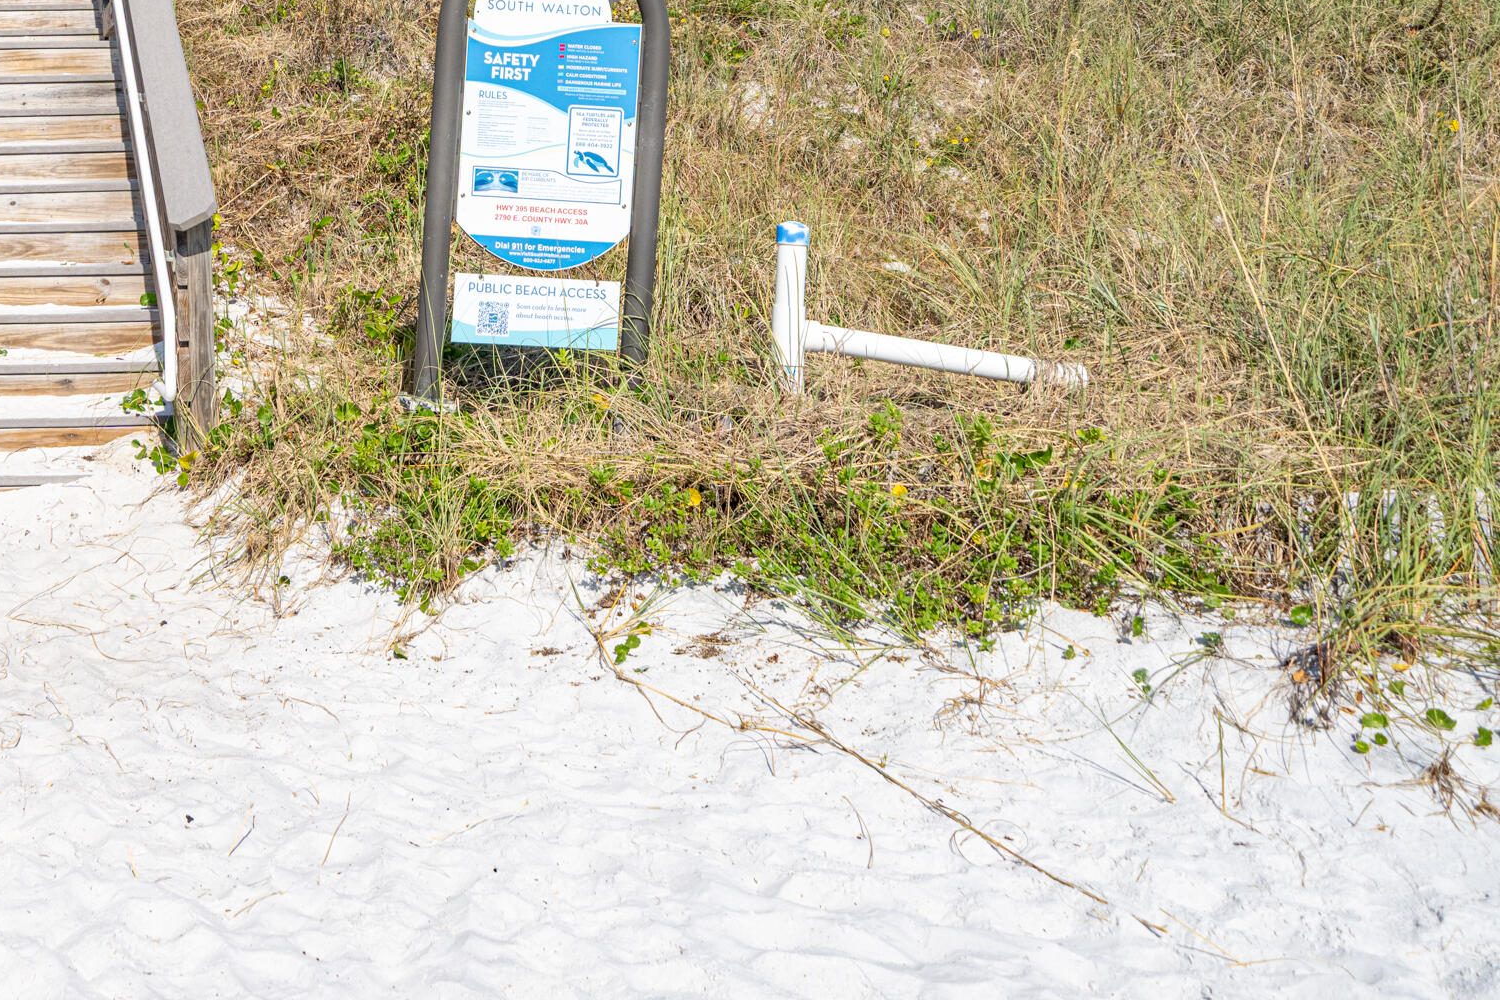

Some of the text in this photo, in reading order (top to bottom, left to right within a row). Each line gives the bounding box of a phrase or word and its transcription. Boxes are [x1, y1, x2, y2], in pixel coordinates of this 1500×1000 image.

[541, 2, 601, 17] WALTON
[484, 51, 540, 67] SAFETY
[491, 66, 532, 81] FIRST
[478, 90, 508, 100] RULES
[496, 204, 588, 216] HWY 395 BEACH ACCESS
[494, 213, 512, 221] 2790
[521, 216, 553, 224] COUNTY
[554, 217, 573, 225] HWY.
[574, 218, 589, 226] 30A
[494, 241, 586, 254] Dial 911 for Emergencies
[468, 281, 607, 300] PUBLIC BEACH ACCESS
[532, 303, 546, 311] code
